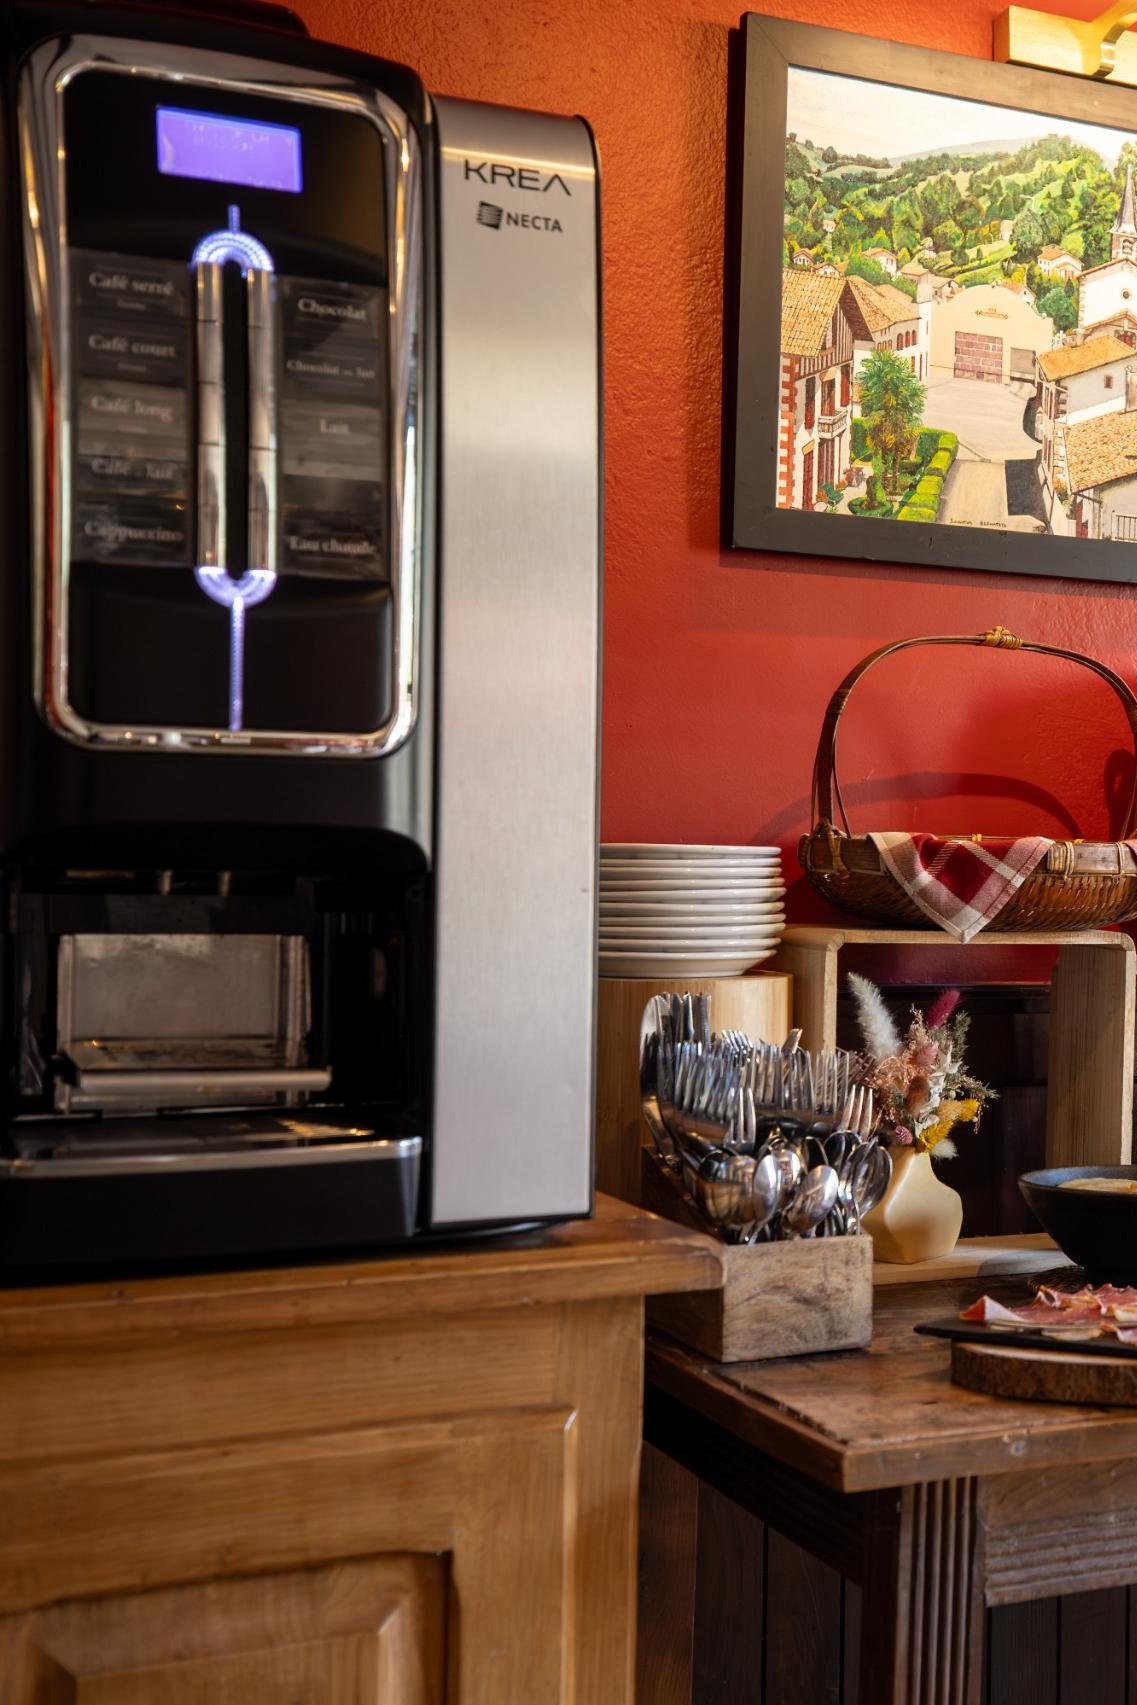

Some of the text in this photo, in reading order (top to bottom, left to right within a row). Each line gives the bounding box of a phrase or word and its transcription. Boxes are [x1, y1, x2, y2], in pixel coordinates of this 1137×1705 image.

[506, 211, 563, 233] NECTA
[89, 272, 128, 290] Café
[298, 298, 367, 319] Chocolat
[89, 334, 176, 358] Café court
[91, 396, 174, 422] Café long
[84, 520, 184, 543] Cappuccino
